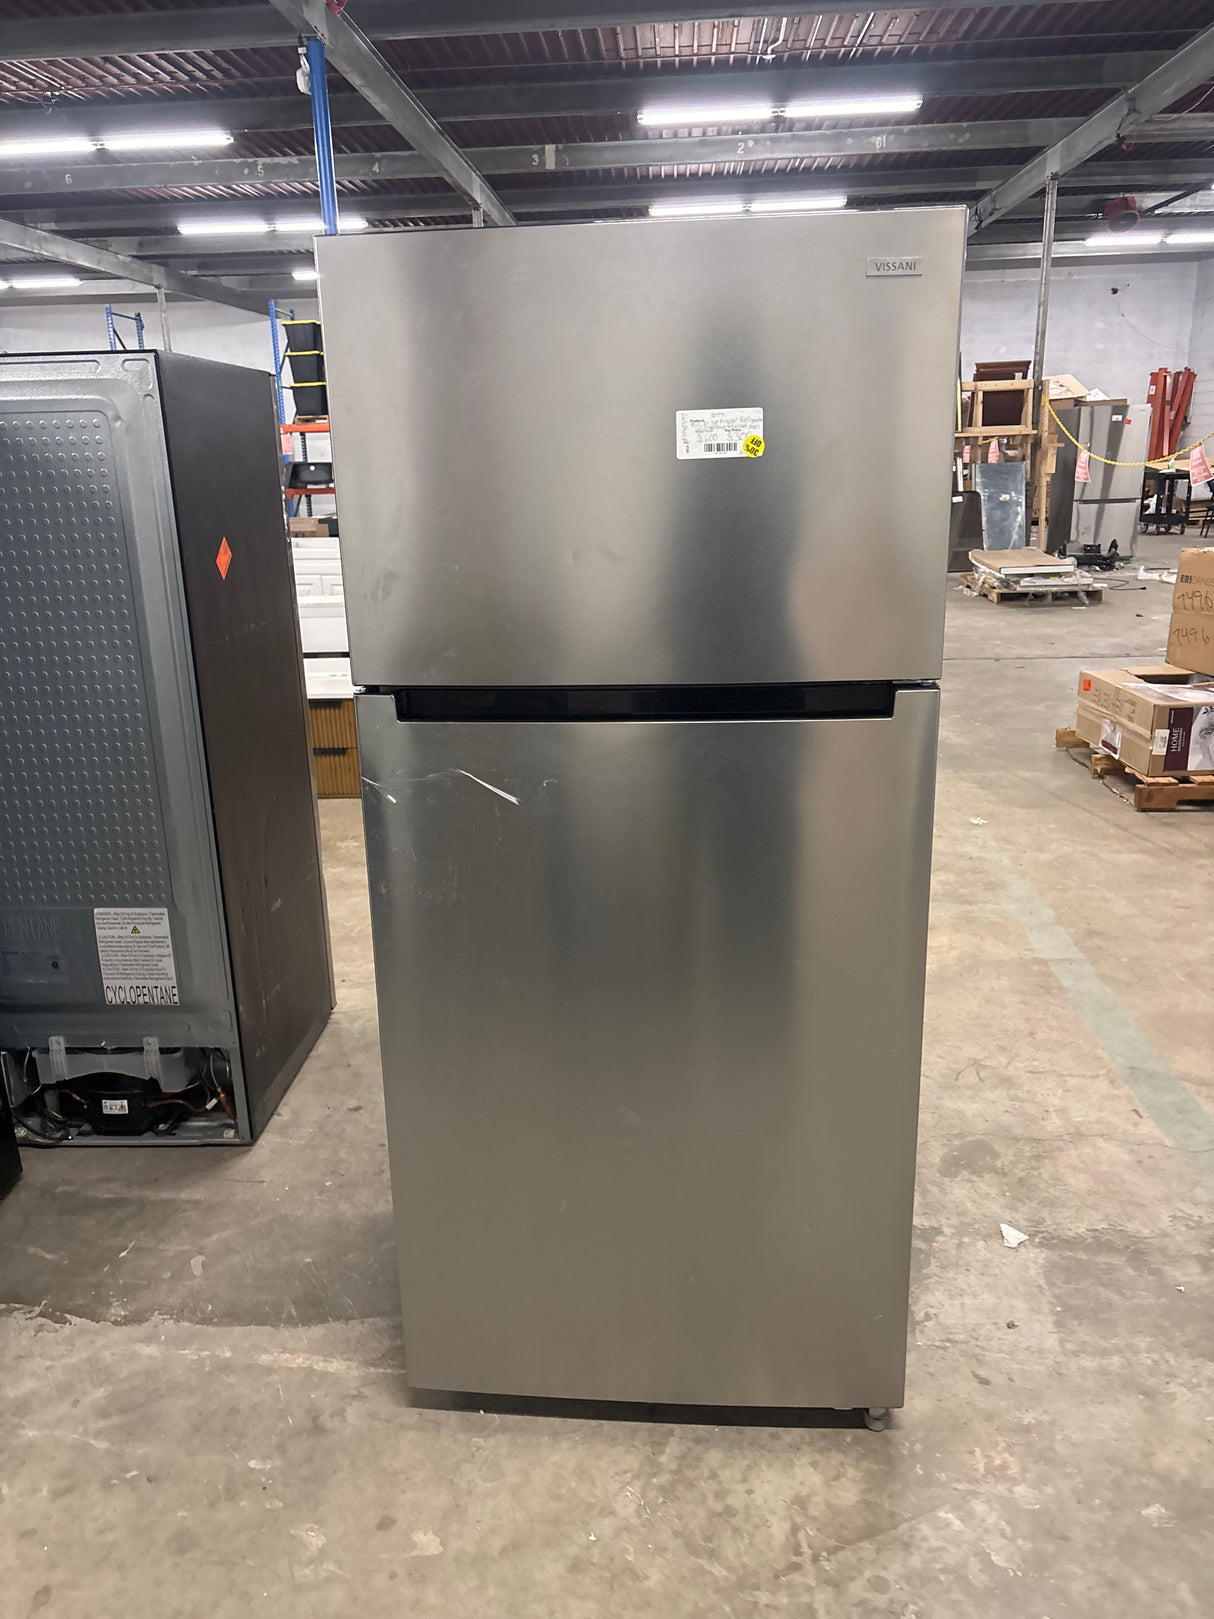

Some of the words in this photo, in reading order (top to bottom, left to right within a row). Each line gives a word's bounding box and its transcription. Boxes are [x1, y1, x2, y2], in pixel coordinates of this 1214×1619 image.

[737, 142, 745, 154] 2
[531, 153, 539, 166] 3
[257, 165, 264, 176] 5
[372, 161, 379, 173] 4
[64, 173, 72, 184] 6
[875, 261, 916, 272] VISSANI
[750, 437, 762, 448] OFF
[745, 443, 760, 457] 30%
[1170, 727, 1180, 752] HOME
[105, 985, 178, 1005] CYCLOPENTANE
